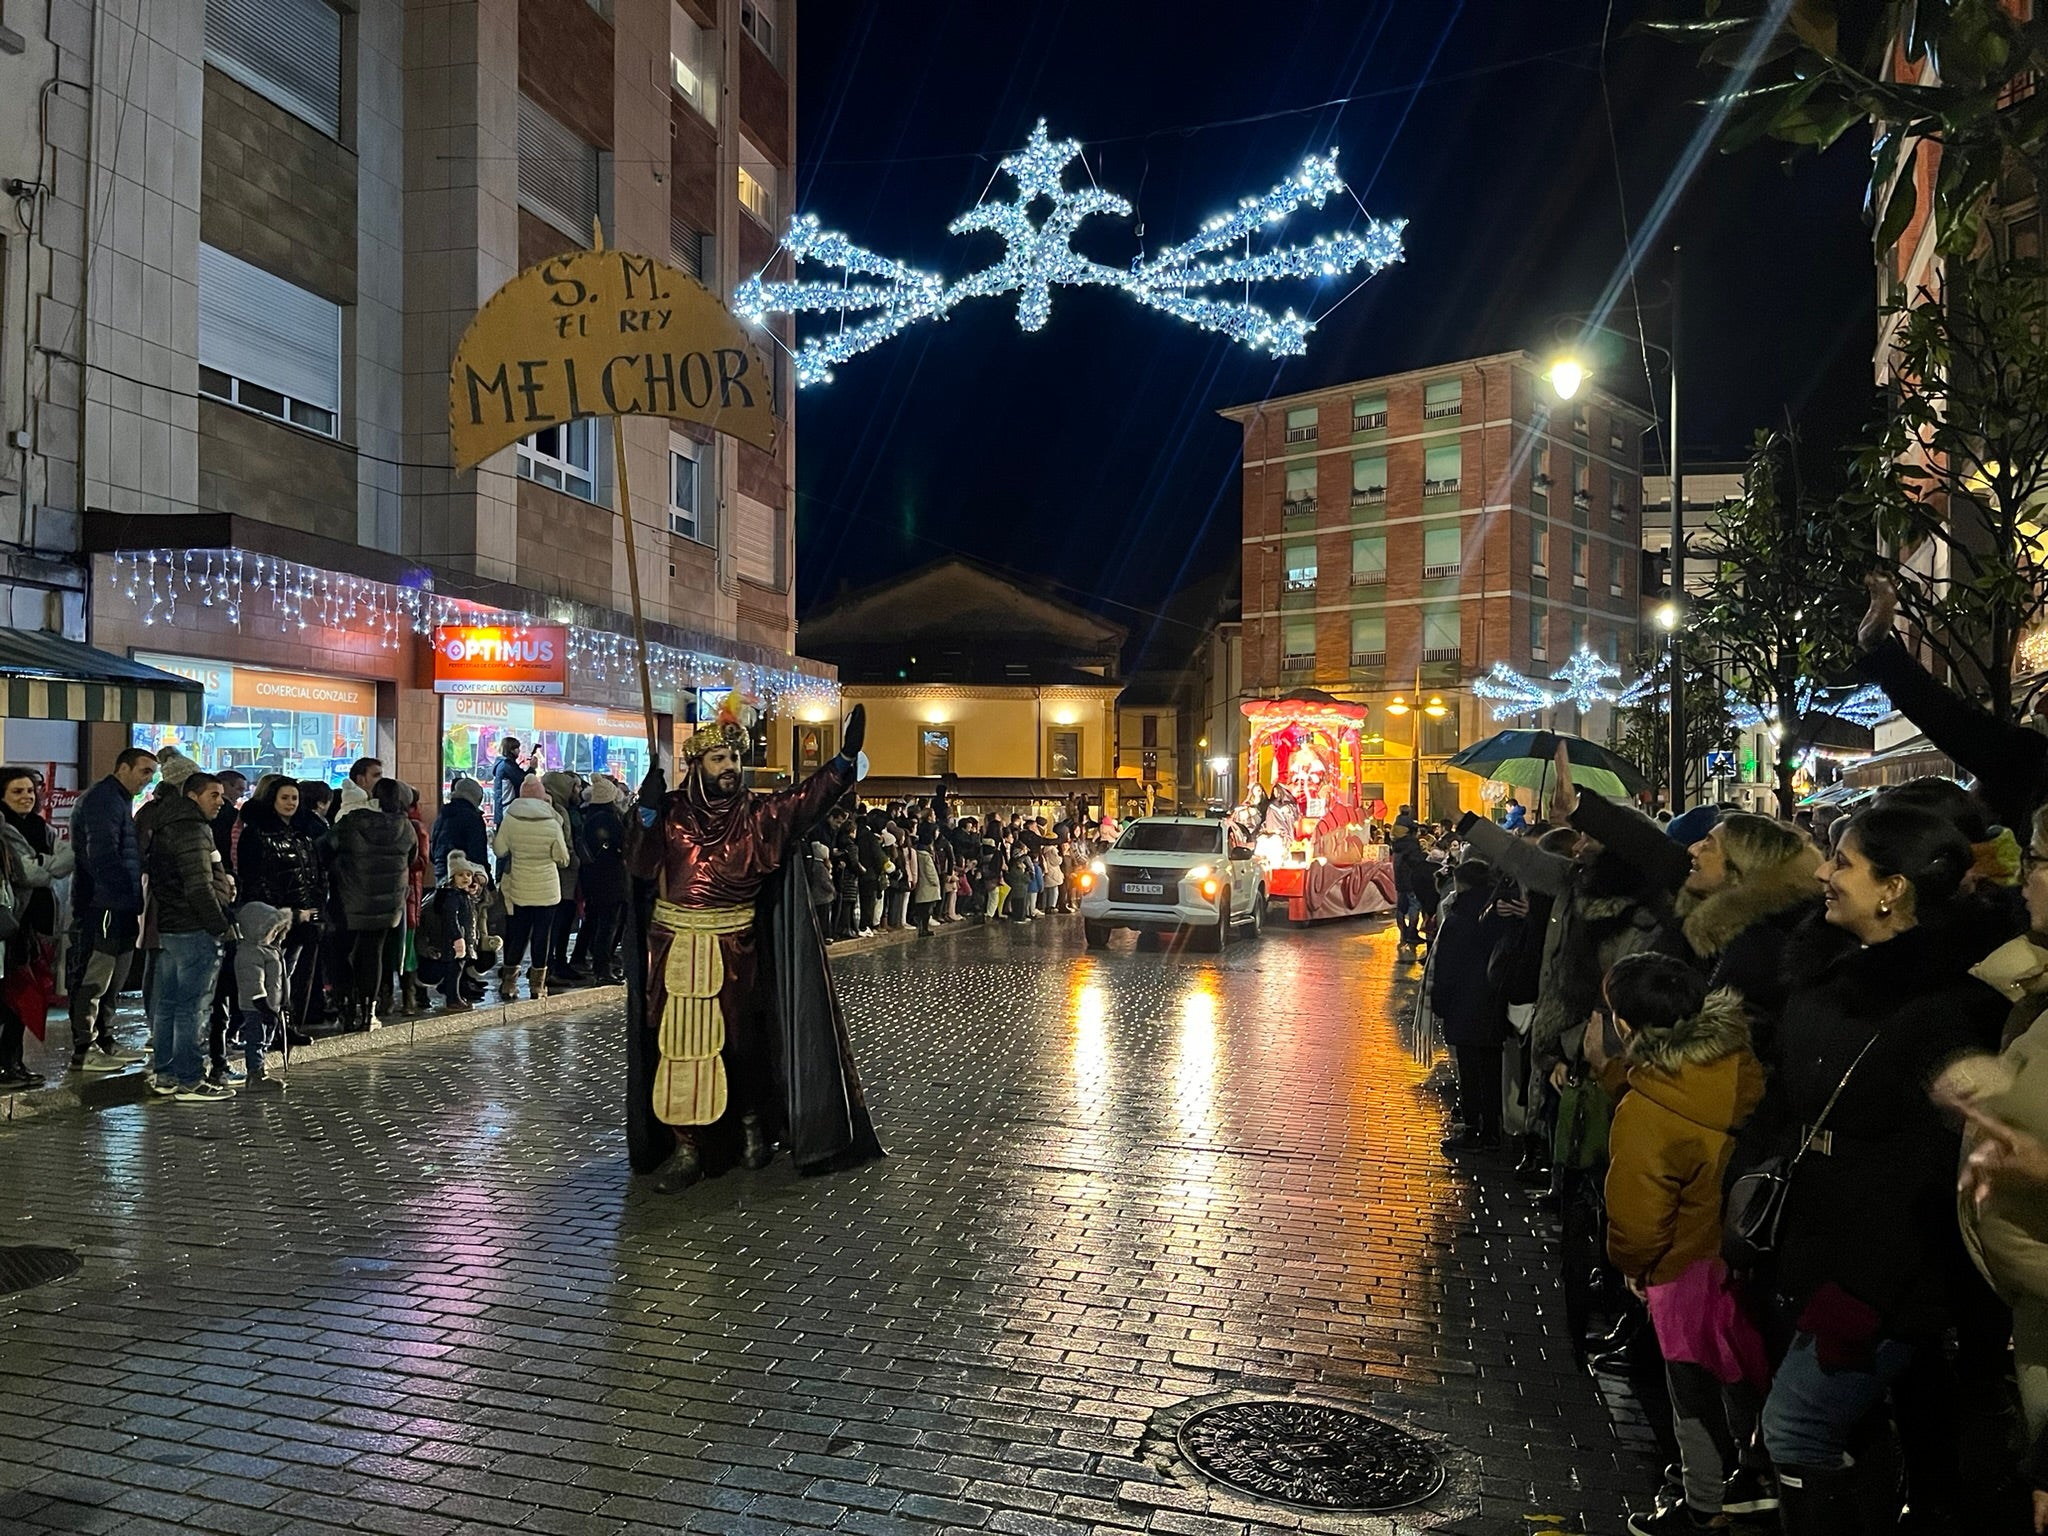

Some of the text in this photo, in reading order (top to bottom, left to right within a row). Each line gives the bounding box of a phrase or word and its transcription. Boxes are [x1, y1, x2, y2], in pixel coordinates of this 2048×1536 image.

[542, 254, 671, 307] S. M.
[619, 308, 672, 334] REY
[465, 349, 755, 425] MELCHOR
[446, 640, 554, 661] OPTIMUS
[256, 683, 359, 704] COMERCIAL GONZALEZ
[451, 683, 546, 694] COMERCIAL GONZALEZ
[456, 698, 508, 717] OPTIMUS
[1126, 884, 1145, 892] 8751
